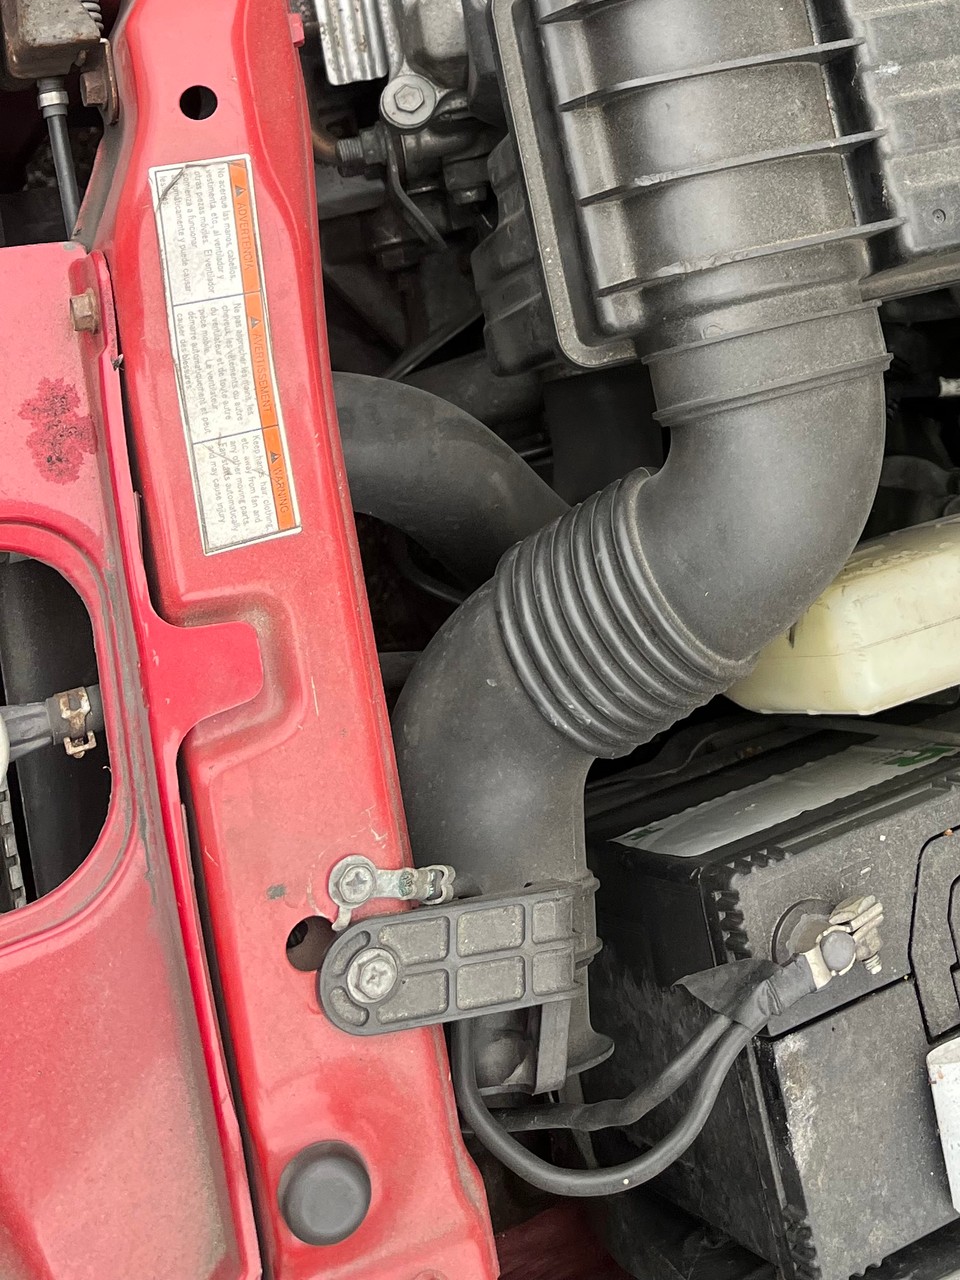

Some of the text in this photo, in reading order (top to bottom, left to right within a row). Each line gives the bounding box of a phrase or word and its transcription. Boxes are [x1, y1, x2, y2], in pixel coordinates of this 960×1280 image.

[193, 171, 201, 189] otras
[216, 167, 225, 178] No
[193, 191, 205, 215] piezas
[215, 179, 228, 208] acerque
[182, 172, 192, 206] comienza
[187, 215, 199, 248] funcionar
[222, 210, 231, 220] las
[236, 201, 254, 270] ADVERTENCIA
[177, 244, 189, 266] puede
[213, 238, 224, 272] ventilador
[204, 258, 216, 293] ventilador
[233, 302, 242, 313] Ne
[233, 315, 242, 327] pas
[179, 339, 188, 351] des
[225, 337, 234, 348] les
[234, 329, 247, 364] approcher
[187, 311, 211, 434] démarre automatiquement et peut
[205, 359, 213, 368] Le
[210, 306, 232, 419] du ventilateur et de toute autre
[227, 350, 239, 388] vêtements
[240, 366, 249, 377] les
[252, 333, 271, 413] AVERTISSEMENT
[206, 370, 219, 410] ventilateur
[232, 390, 239, 399] ou
[234, 401, 243, 421] autre
[246, 404, 255, 415] les
[228, 440, 237, 453] any
[251, 435, 261, 454] Keep
[209, 461, 218, 477] may
[232, 455, 242, 475] other
[242, 455, 252, 474] away
[212, 478, 222, 500] cause
[234, 477, 245, 504] moving
[248, 476, 257, 493] from
[274, 466, 288, 513] WARNING
[225, 482, 241, 531] automatically
[251, 495, 259, 507] fan
[252, 509, 261, 523] and
